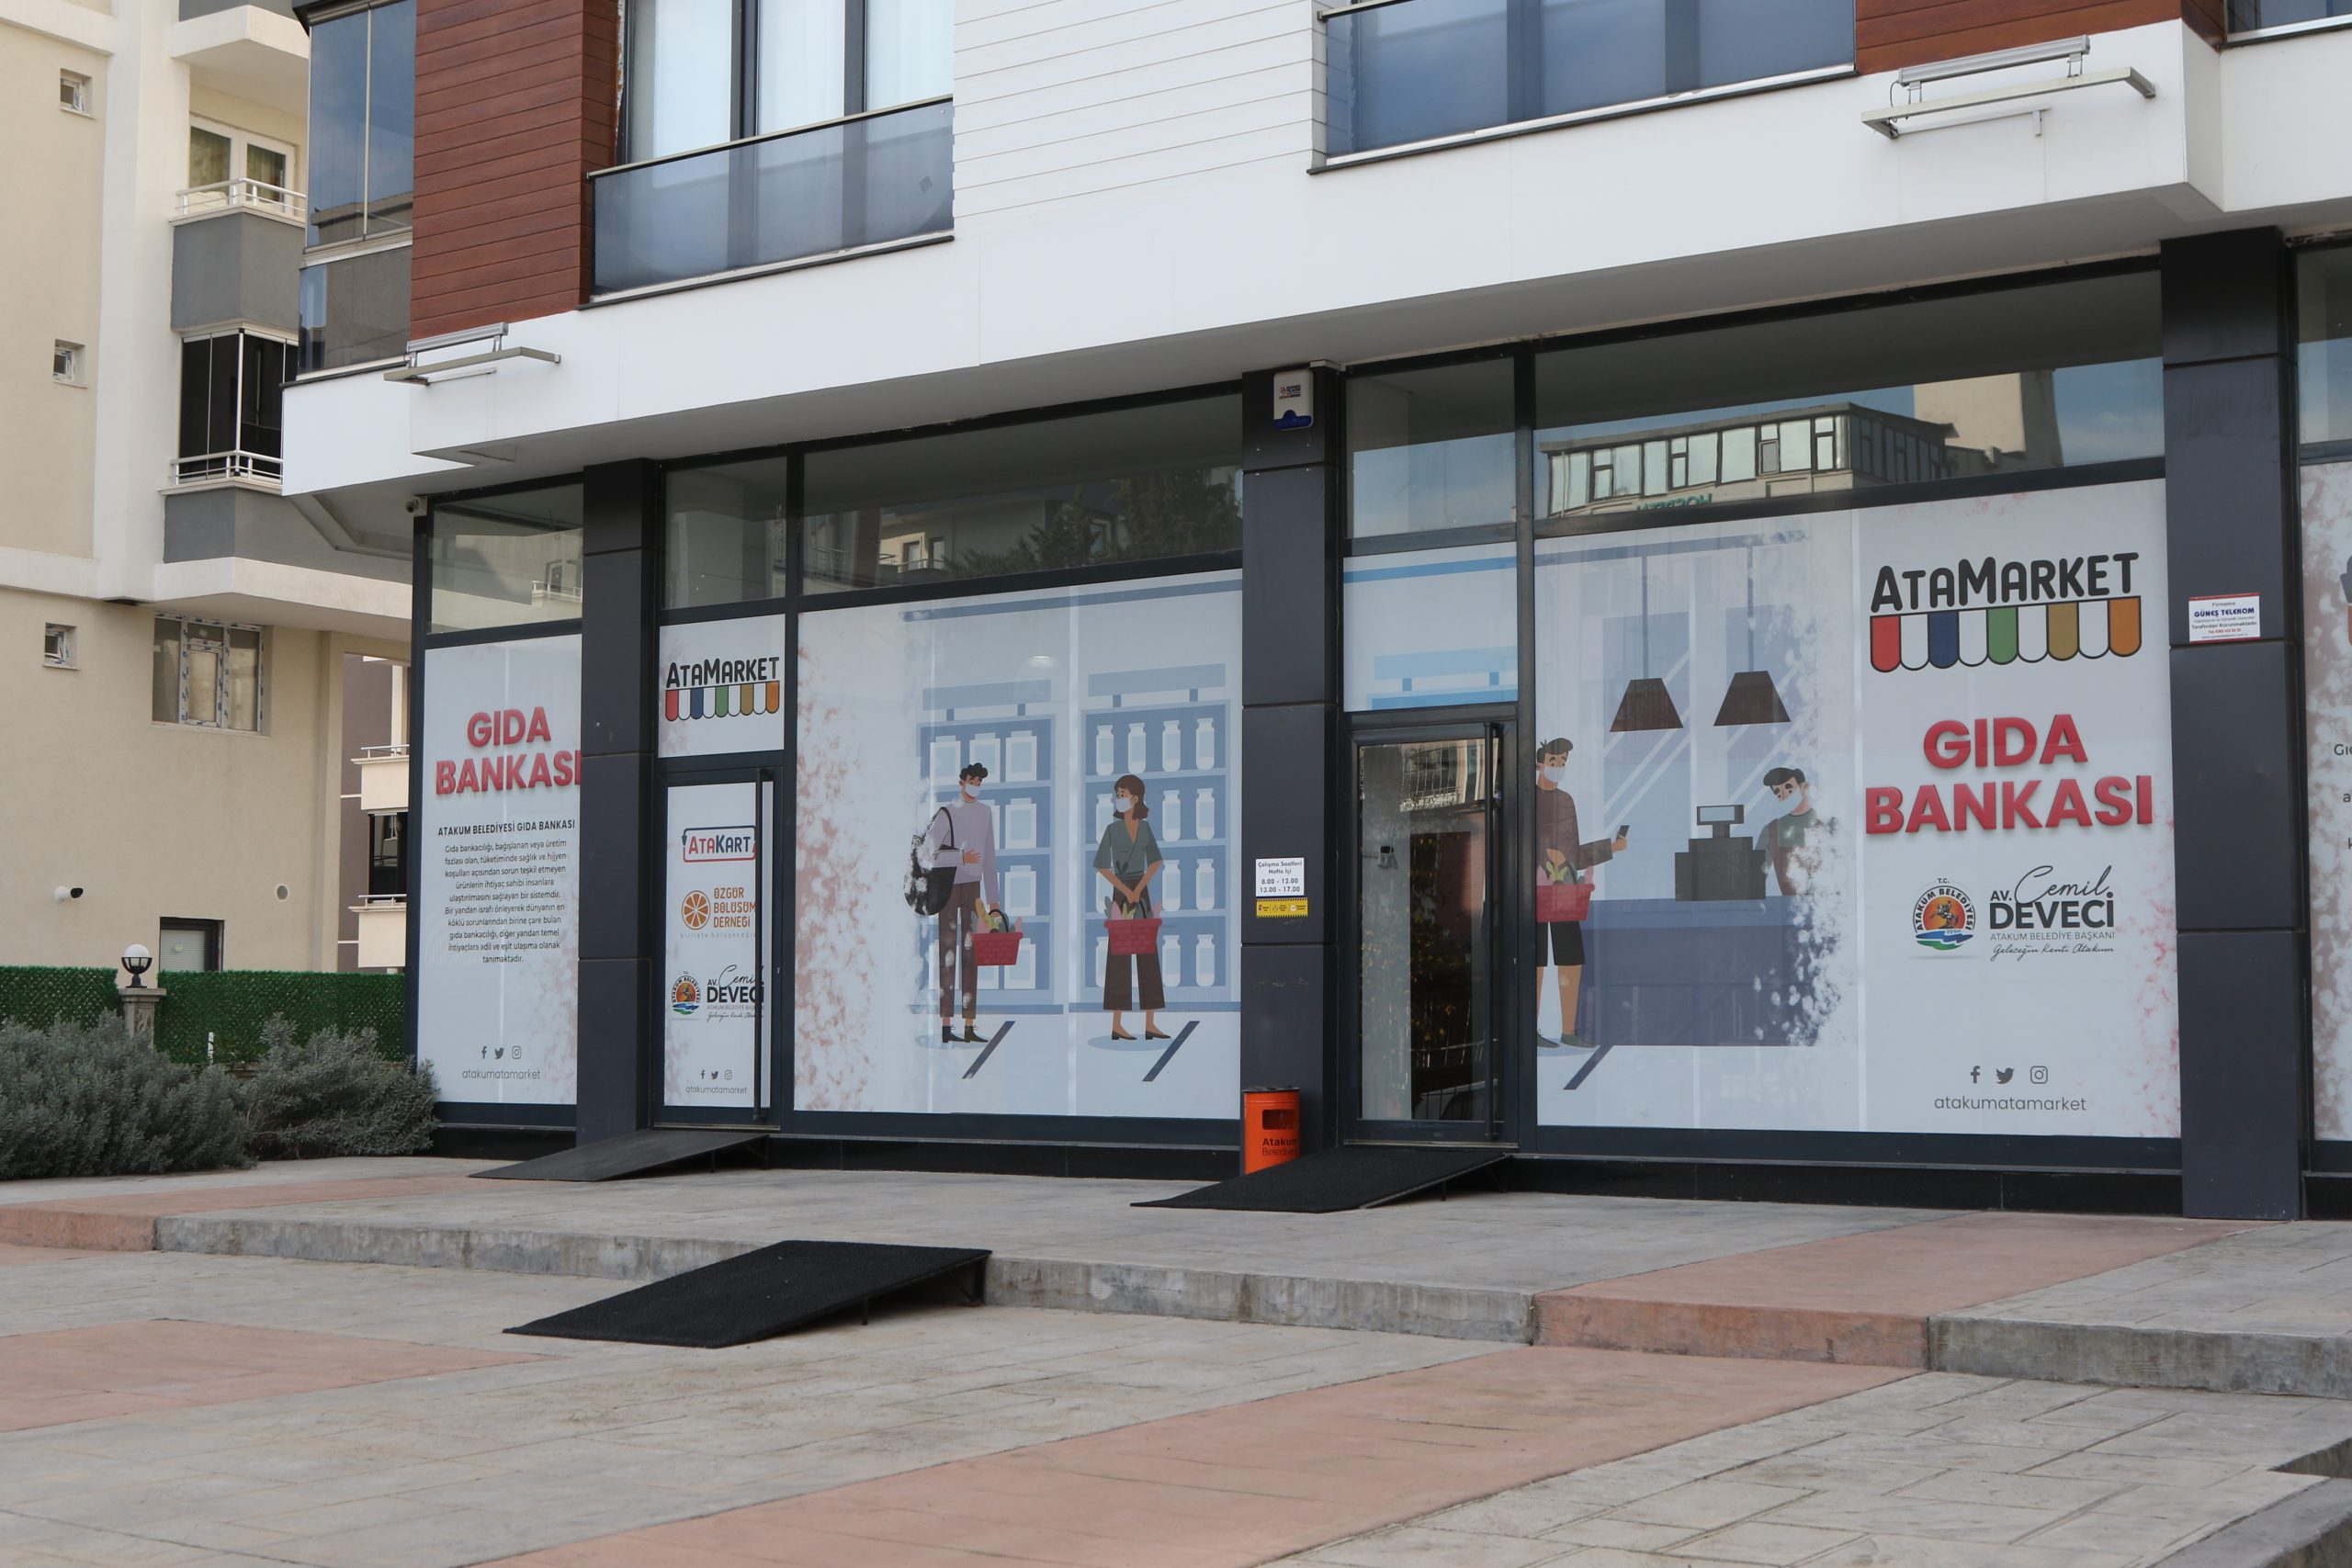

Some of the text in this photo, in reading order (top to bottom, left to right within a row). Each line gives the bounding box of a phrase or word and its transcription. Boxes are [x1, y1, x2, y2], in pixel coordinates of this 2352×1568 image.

[2194, 607, 2255, 617] GÜNEŞ TELEKOM
[468, 706, 551, 748] GIDA
[1923, 714, 2088, 769] GIDA
[435, 750, 582, 795] BANKASI
[1865, 775, 2153, 834] BANKASI
[438, 819, 575, 836] ATAKUM BELEDİYESİ GIDA BANKASI
[530, 841, 544, 850] veya
[445, 857, 463, 865] fazlası
[481, 854, 517, 863] tüketiminde
[519, 853, 537, 863] sağlık
[548, 852, 566, 862] hijyen
[445, 870, 469, 879] koşulları
[471, 869, 500, 877] açısından
[520, 866, 537, 875] teşkil
[456, 881, 483, 889] ürünlerin
[484, 879, 504, 889] ihtiyaç
[1990, 865, 2112, 904] AV. Cemil
[492, 892, 518, 901] sağlayan
[530, 890, 560, 898] sistemdir.
[455, 906, 477, 916] yandan
[478, 905, 493, 913] israfı
[494, 904, 525, 914] önleyerek
[526, 904, 555, 912] dünyanın
[1916, 891, 1936, 931] ATAKUM
[1990, 892, 2114, 929] DEVECİ
[466, 918, 507, 926] sorunlarından
[449, 931, 462, 941] gıda
[500, 930, 514, 939] diğer
[516, 929, 539, 939] yandan
[541, 928, 560, 936] temel
[2030, 931, 2072, 940] BELEDİYE
[2075, 931, 2115, 941] BAŞKANI
[448, 942, 479, 953] ihtiyaçlara
[481, 942, 492, 951] adil
[502, 942, 512, 952] eşit
[514, 942, 537, 952] ulaşıma
[1990, 942, 2114, 962] Geleceğin Kenti Atakum
[718, 964, 763, 987] Cemi
[462, 1068, 540, 1079] atakumatamarket
[685, 1086, 747, 1094] atakumatamarket
[1934, 1096, 2086, 1111] atakumatamarket
